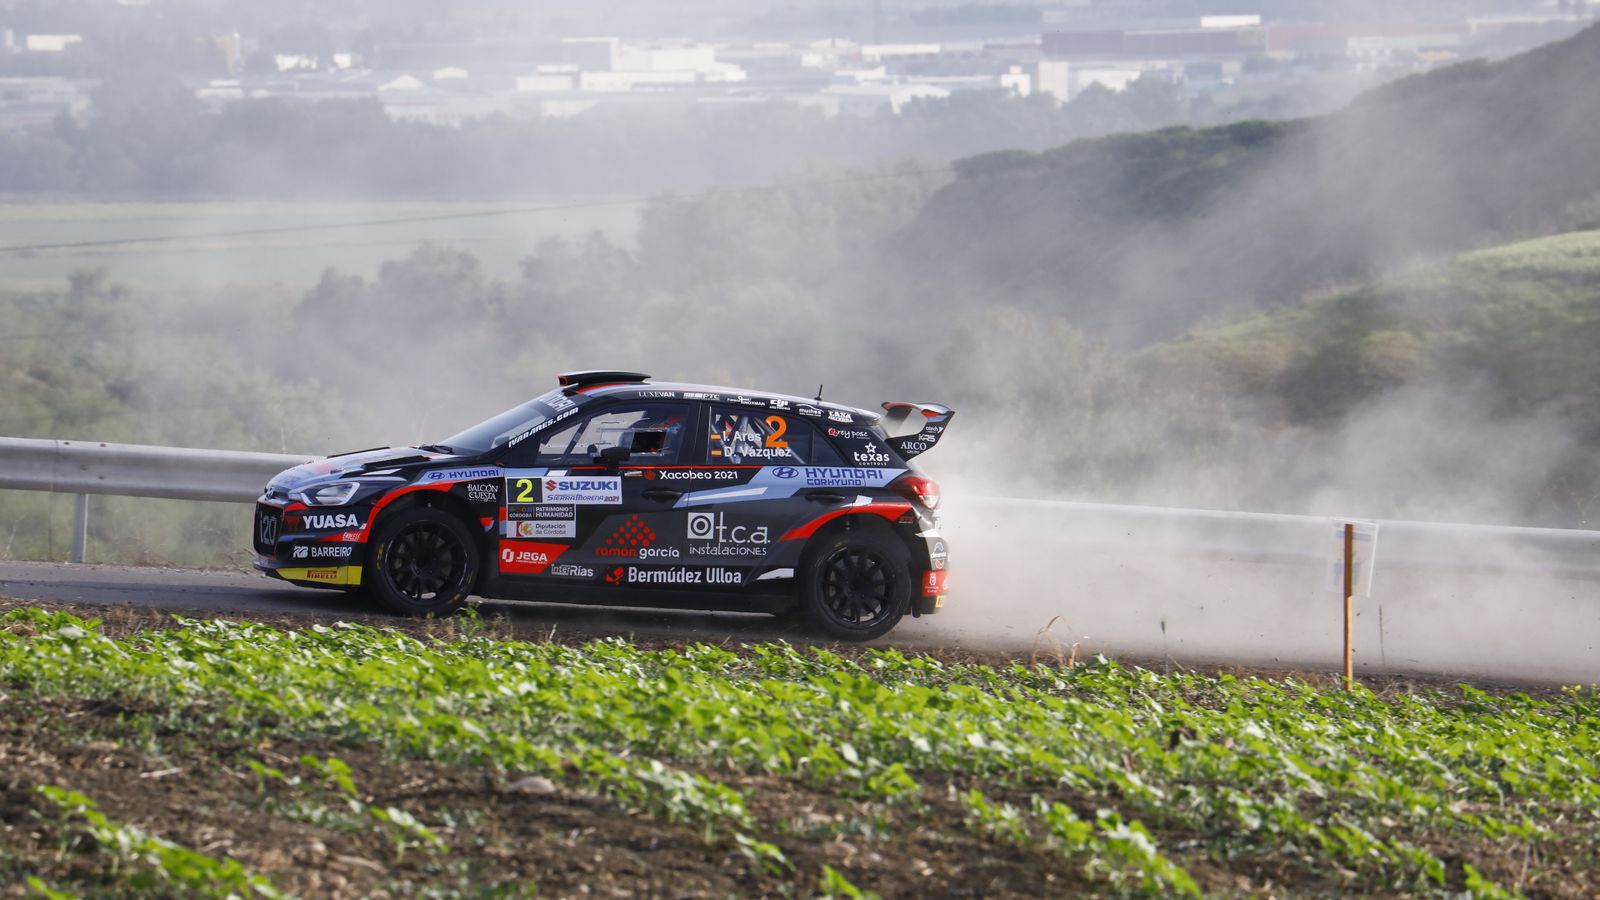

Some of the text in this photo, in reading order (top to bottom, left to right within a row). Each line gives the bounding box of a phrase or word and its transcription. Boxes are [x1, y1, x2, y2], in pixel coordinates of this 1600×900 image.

[735, 431, 761, 442] Ares
[765, 415, 789, 449] 2
[900, 441, 927, 451] ARCO
[724, 446, 792, 459] D. Vázquez
[853, 451, 890, 462] texas
[448, 469, 499, 479] HYUNDAI
[659, 469, 738, 480] Xacobeo 2021
[805, 467, 884, 479] HYUNDAI
[516, 478, 534, 503] 2
[558, 481, 618, 491] SUZUKI
[303, 514, 359, 529] YUASA
[311, 546, 352, 558] BARREIRO
[639, 547, 680, 560] garcía
[306, 570, 337, 579] PIRELLI
[628, 566, 742, 583] Bermúdez Ulloa
